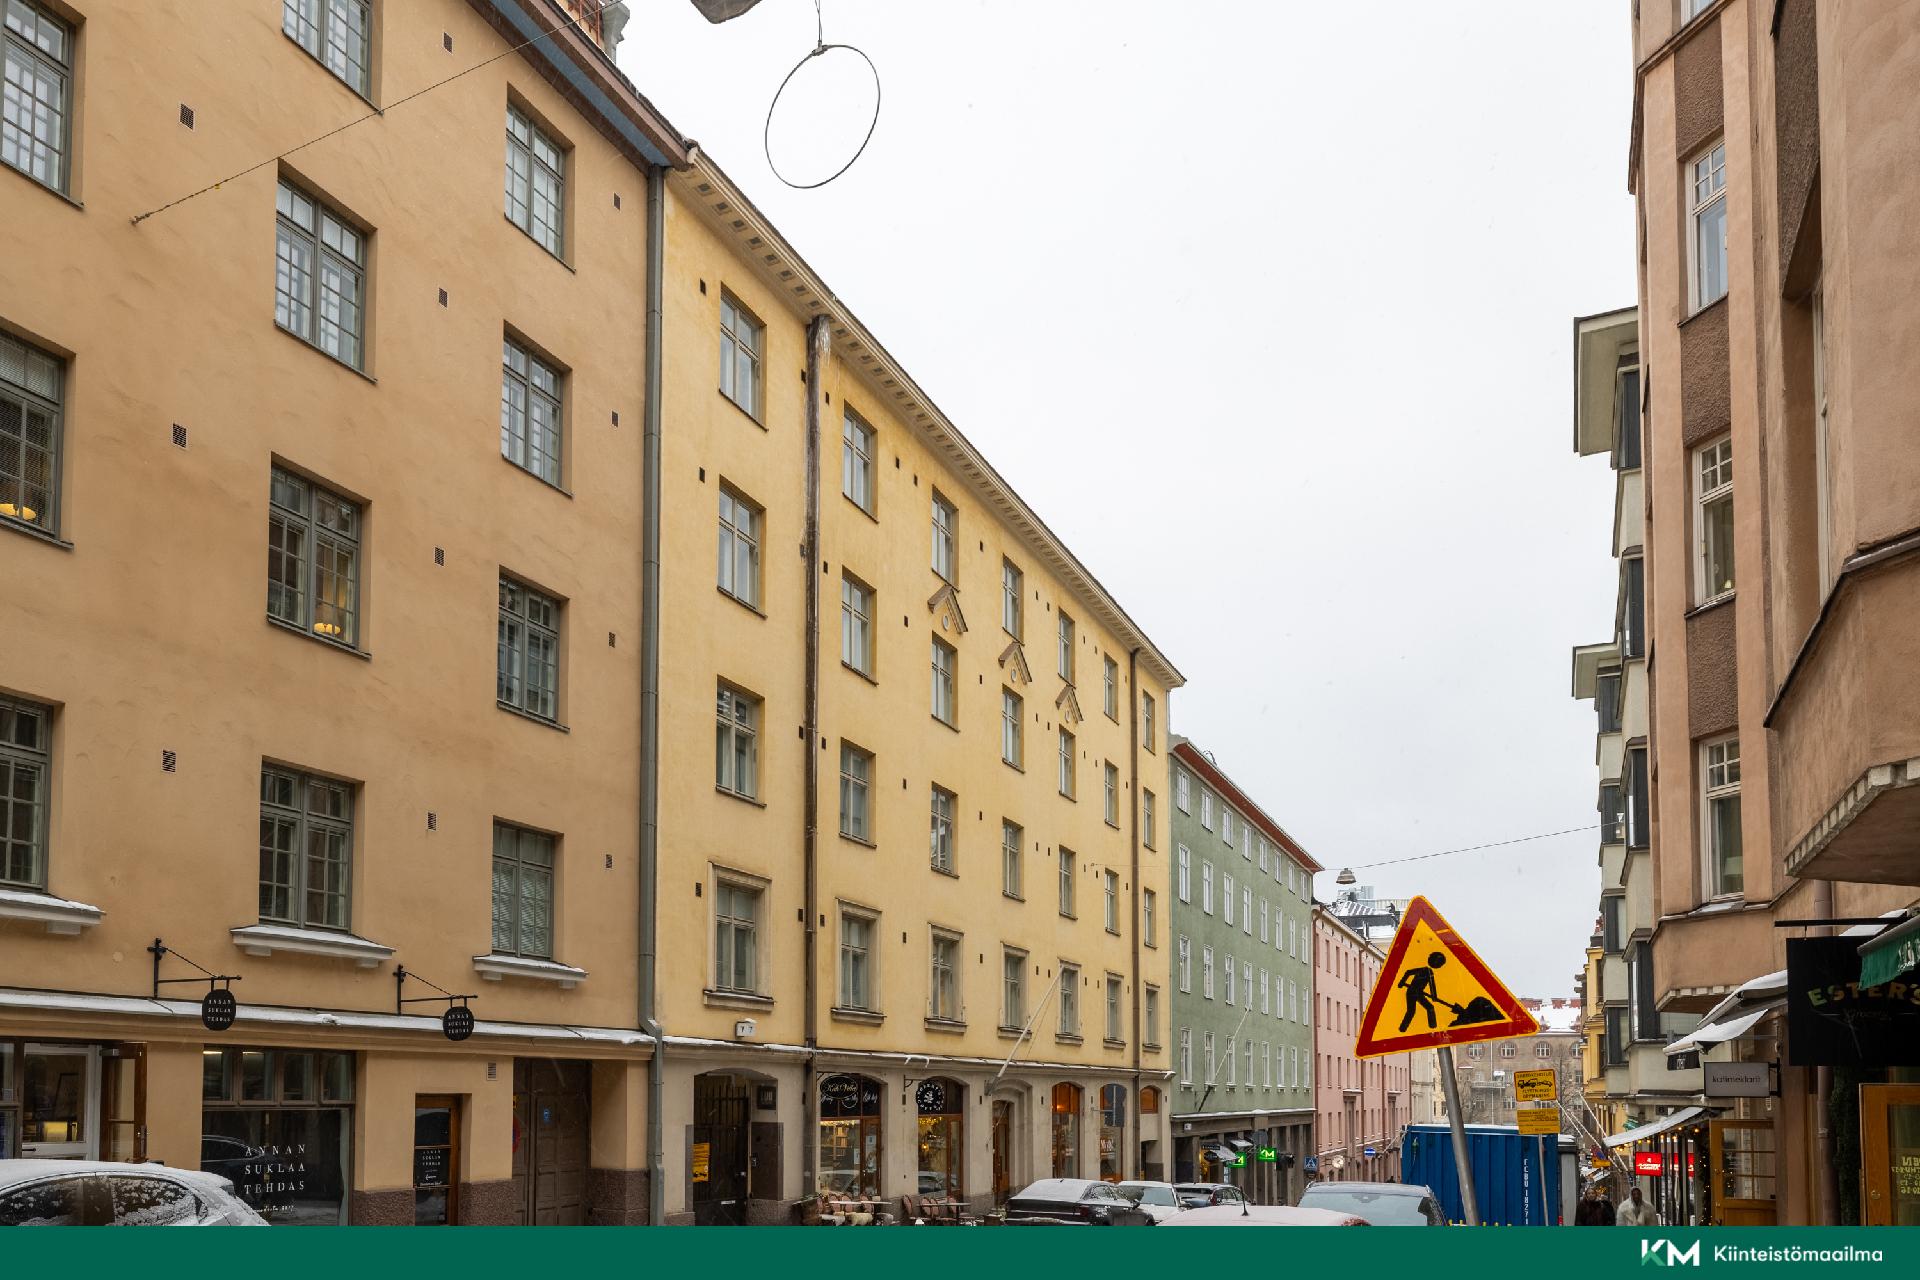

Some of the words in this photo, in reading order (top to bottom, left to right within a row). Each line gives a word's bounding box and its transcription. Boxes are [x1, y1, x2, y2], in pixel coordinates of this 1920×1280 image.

[245, 1144, 306, 1157] ANNAN
[244, 1162, 305, 1174] SUKLAA
[244, 1180, 305, 1194] TEHDAS
